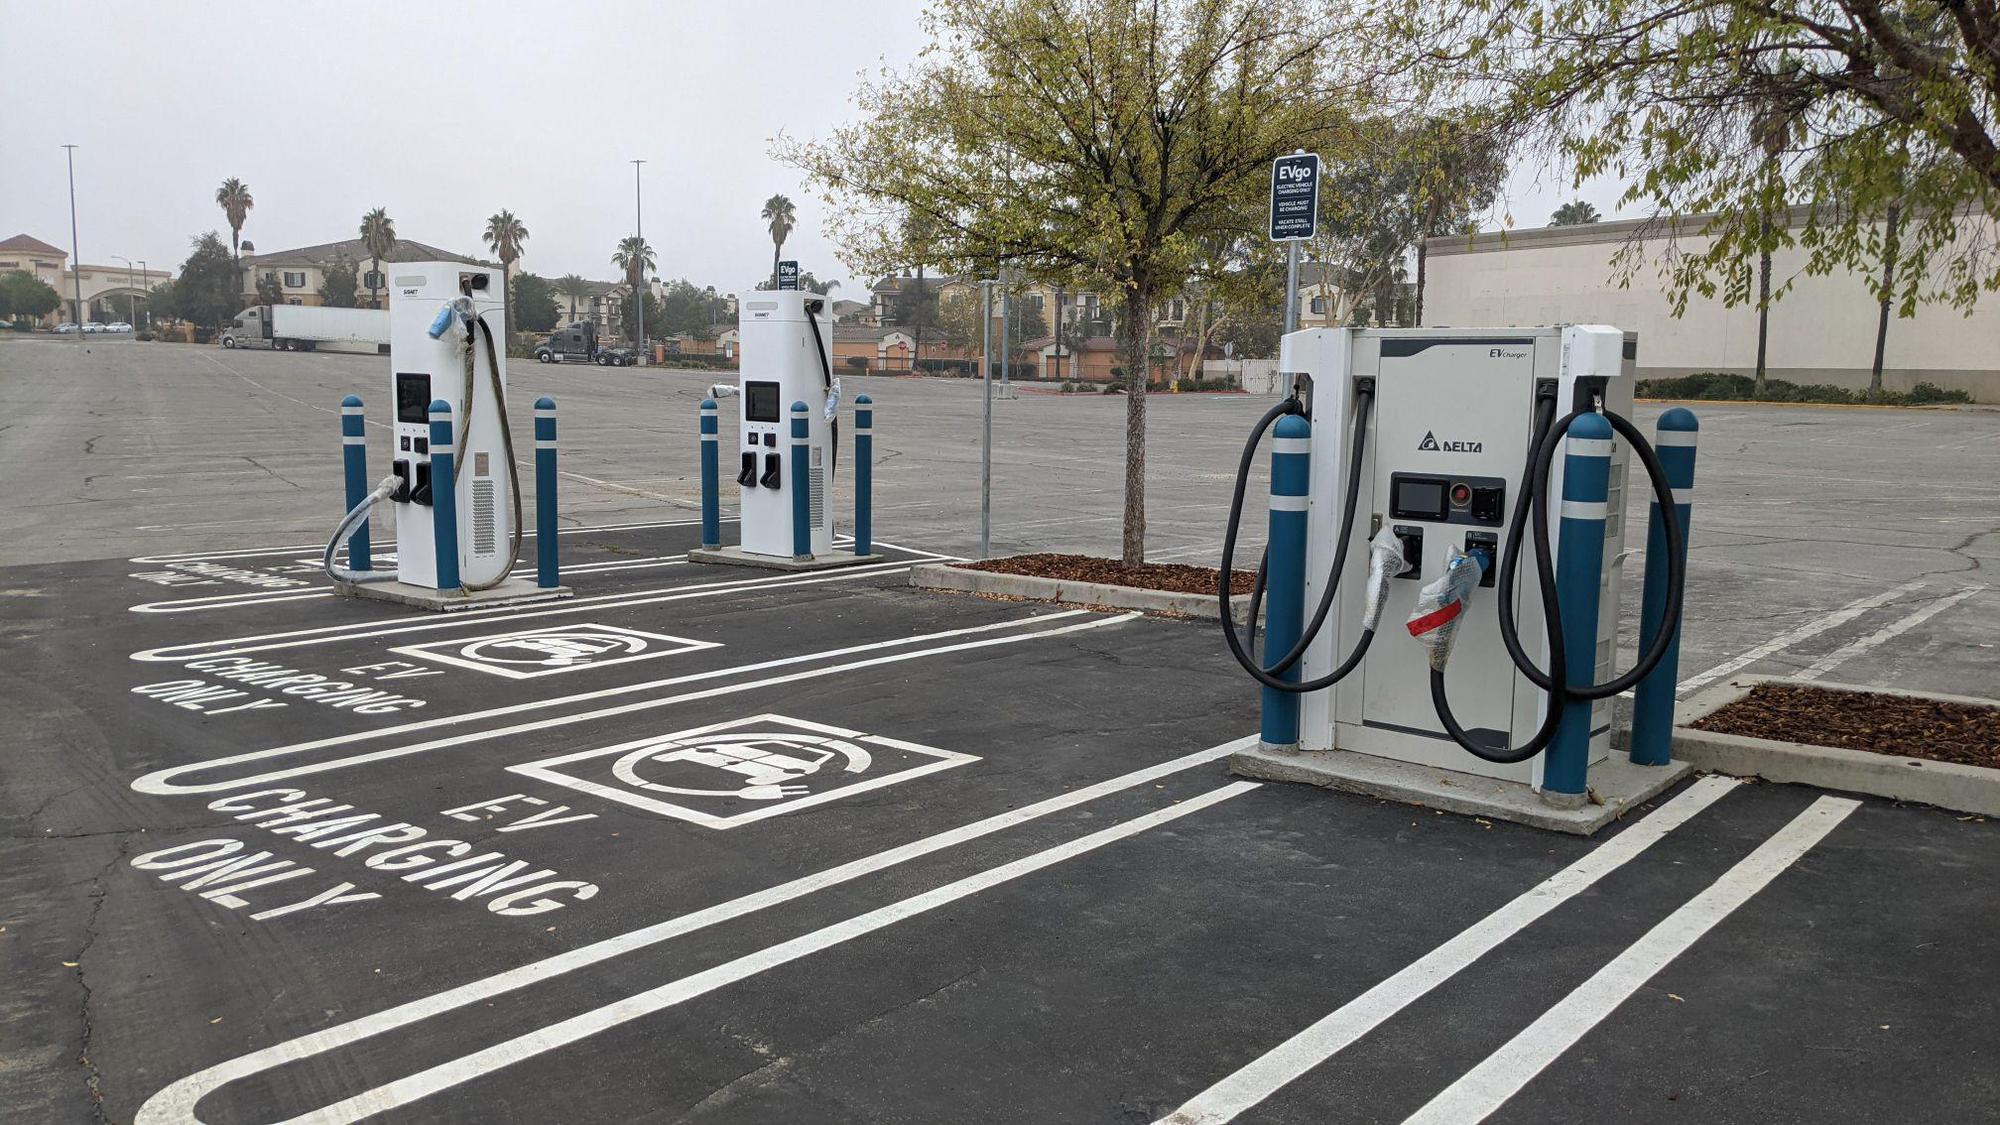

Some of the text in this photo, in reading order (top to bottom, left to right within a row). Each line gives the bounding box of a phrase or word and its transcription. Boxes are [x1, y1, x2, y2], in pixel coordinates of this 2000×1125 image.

[1279, 165, 1311, 181] EVgo
[1443, 441, 1482, 453] DELTA
[184, 657, 427, 714] CHARGING
[340, 661, 446, 680] EV
[130, 680, 289, 715] ONLY
[439, 793, 600, 833] EV
[207, 788, 600, 916] CHARGING
[130, 838, 383, 921] ONLY
